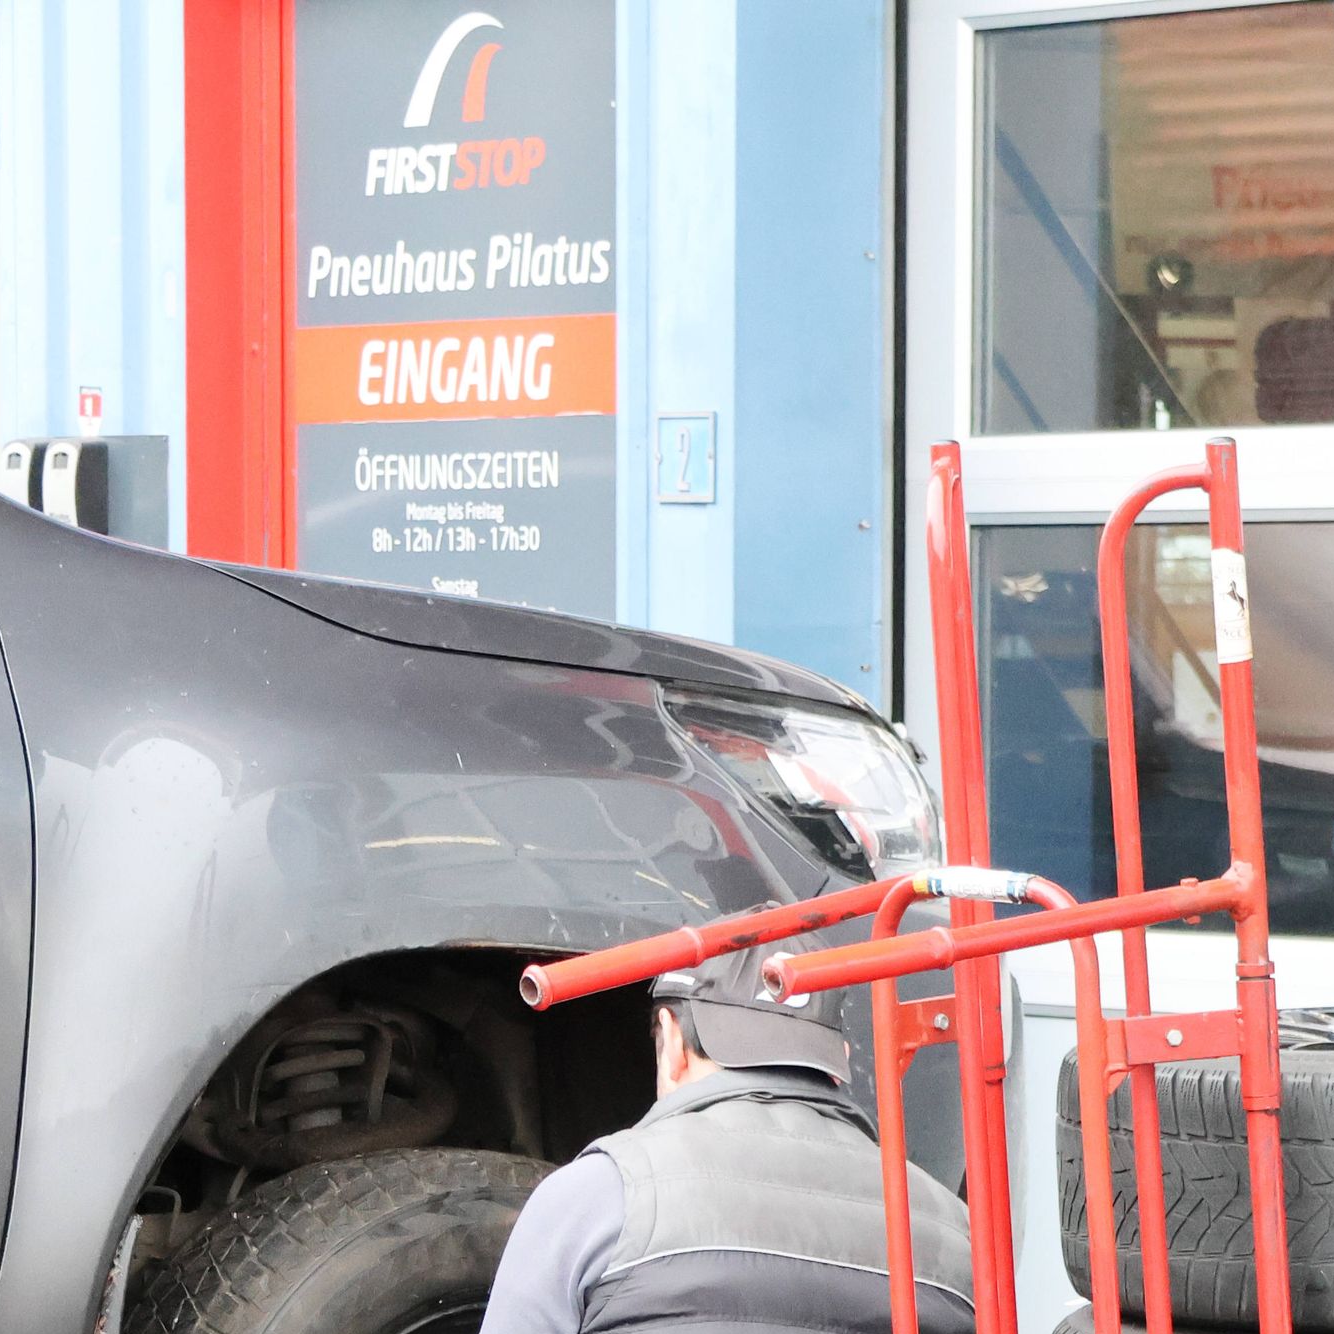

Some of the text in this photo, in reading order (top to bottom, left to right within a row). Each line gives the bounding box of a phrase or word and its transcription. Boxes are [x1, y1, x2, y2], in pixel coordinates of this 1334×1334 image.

[308, 232, 611, 298] Pneuhaus Pilatus
[358, 333, 555, 405] EINGANG
[354, 449, 559, 491] ÖFFNUNGSZEITEN
[675, 426, 692, 493] 2
[372, 527, 393, 553] 8h
[403, 527, 432, 552] 12h
[447, 526, 476, 552] 13h
[490, 525, 540, 551] 17h30
[405, 501, 504, 524] Montag bis Freitag
